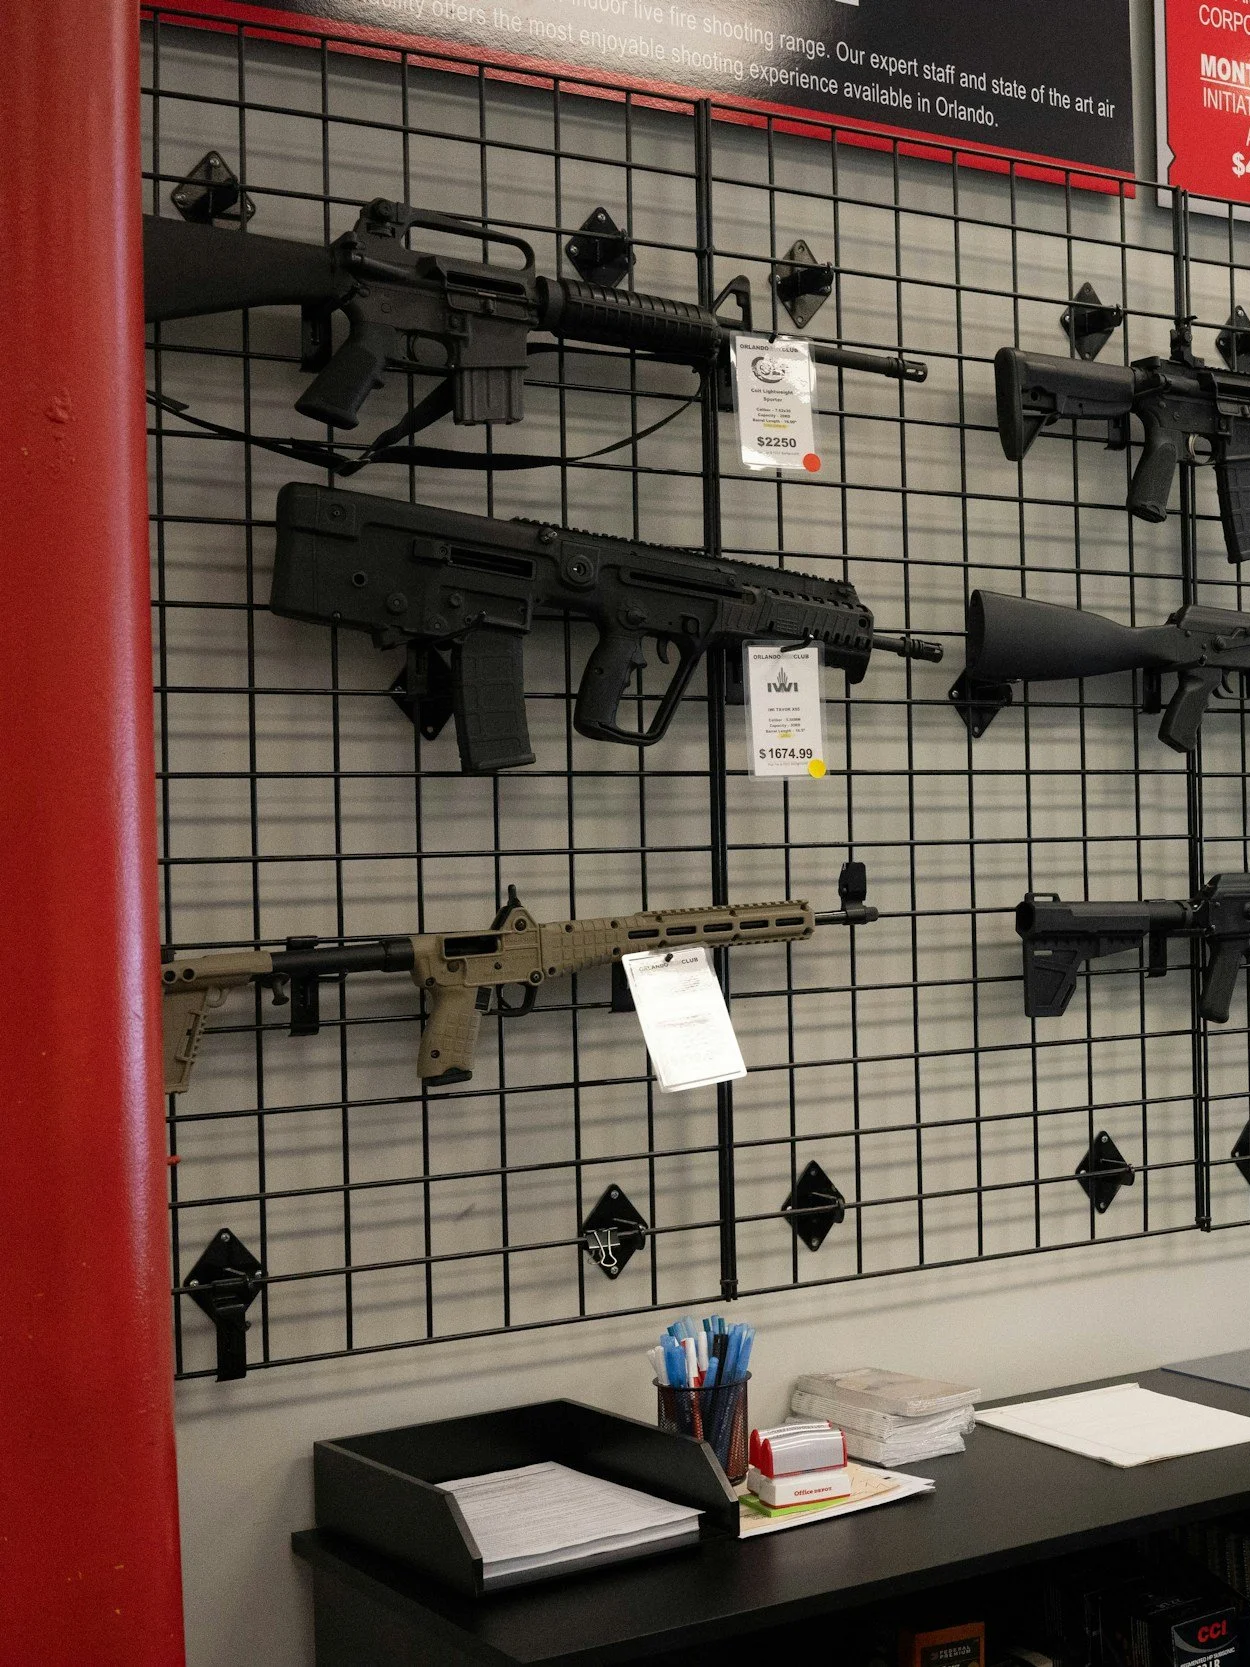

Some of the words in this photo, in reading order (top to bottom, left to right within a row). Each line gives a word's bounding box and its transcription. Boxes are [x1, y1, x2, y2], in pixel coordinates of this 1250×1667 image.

[432, 1, 486, 25] offers
[493, 8, 522, 32] the
[529, 19, 573, 42] most
[580, 29, 665, 60] enjoyable
[672, 46, 744, 80] shooting
[750, 63, 838, 94] experience
[844, 81, 912, 110] available
[917, 91, 931, 113] in
[936, 96, 999, 127] Orlando.
[634, 0, 663, 22] live
[669, 6, 697, 29] fire
[703, 15, 774, 51] shooting
[780, 33, 830, 59] range.
[836, 41, 866, 65] Our
[870, 53, 918, 77] expert
[923, 63, 955, 85] staff
[959, 72, 987, 92] and
[991, 78, 1027, 100] state
[1031, 85, 1046, 103] of
[1049, 87, 1071, 109] the
[1075, 95, 1094, 114] art
[1097, 99, 1116, 118] air
[757, 436, 797, 448] $2250
[767, 682, 799, 693] IWI
[1197, 1619, 1228, 1644] CCI
